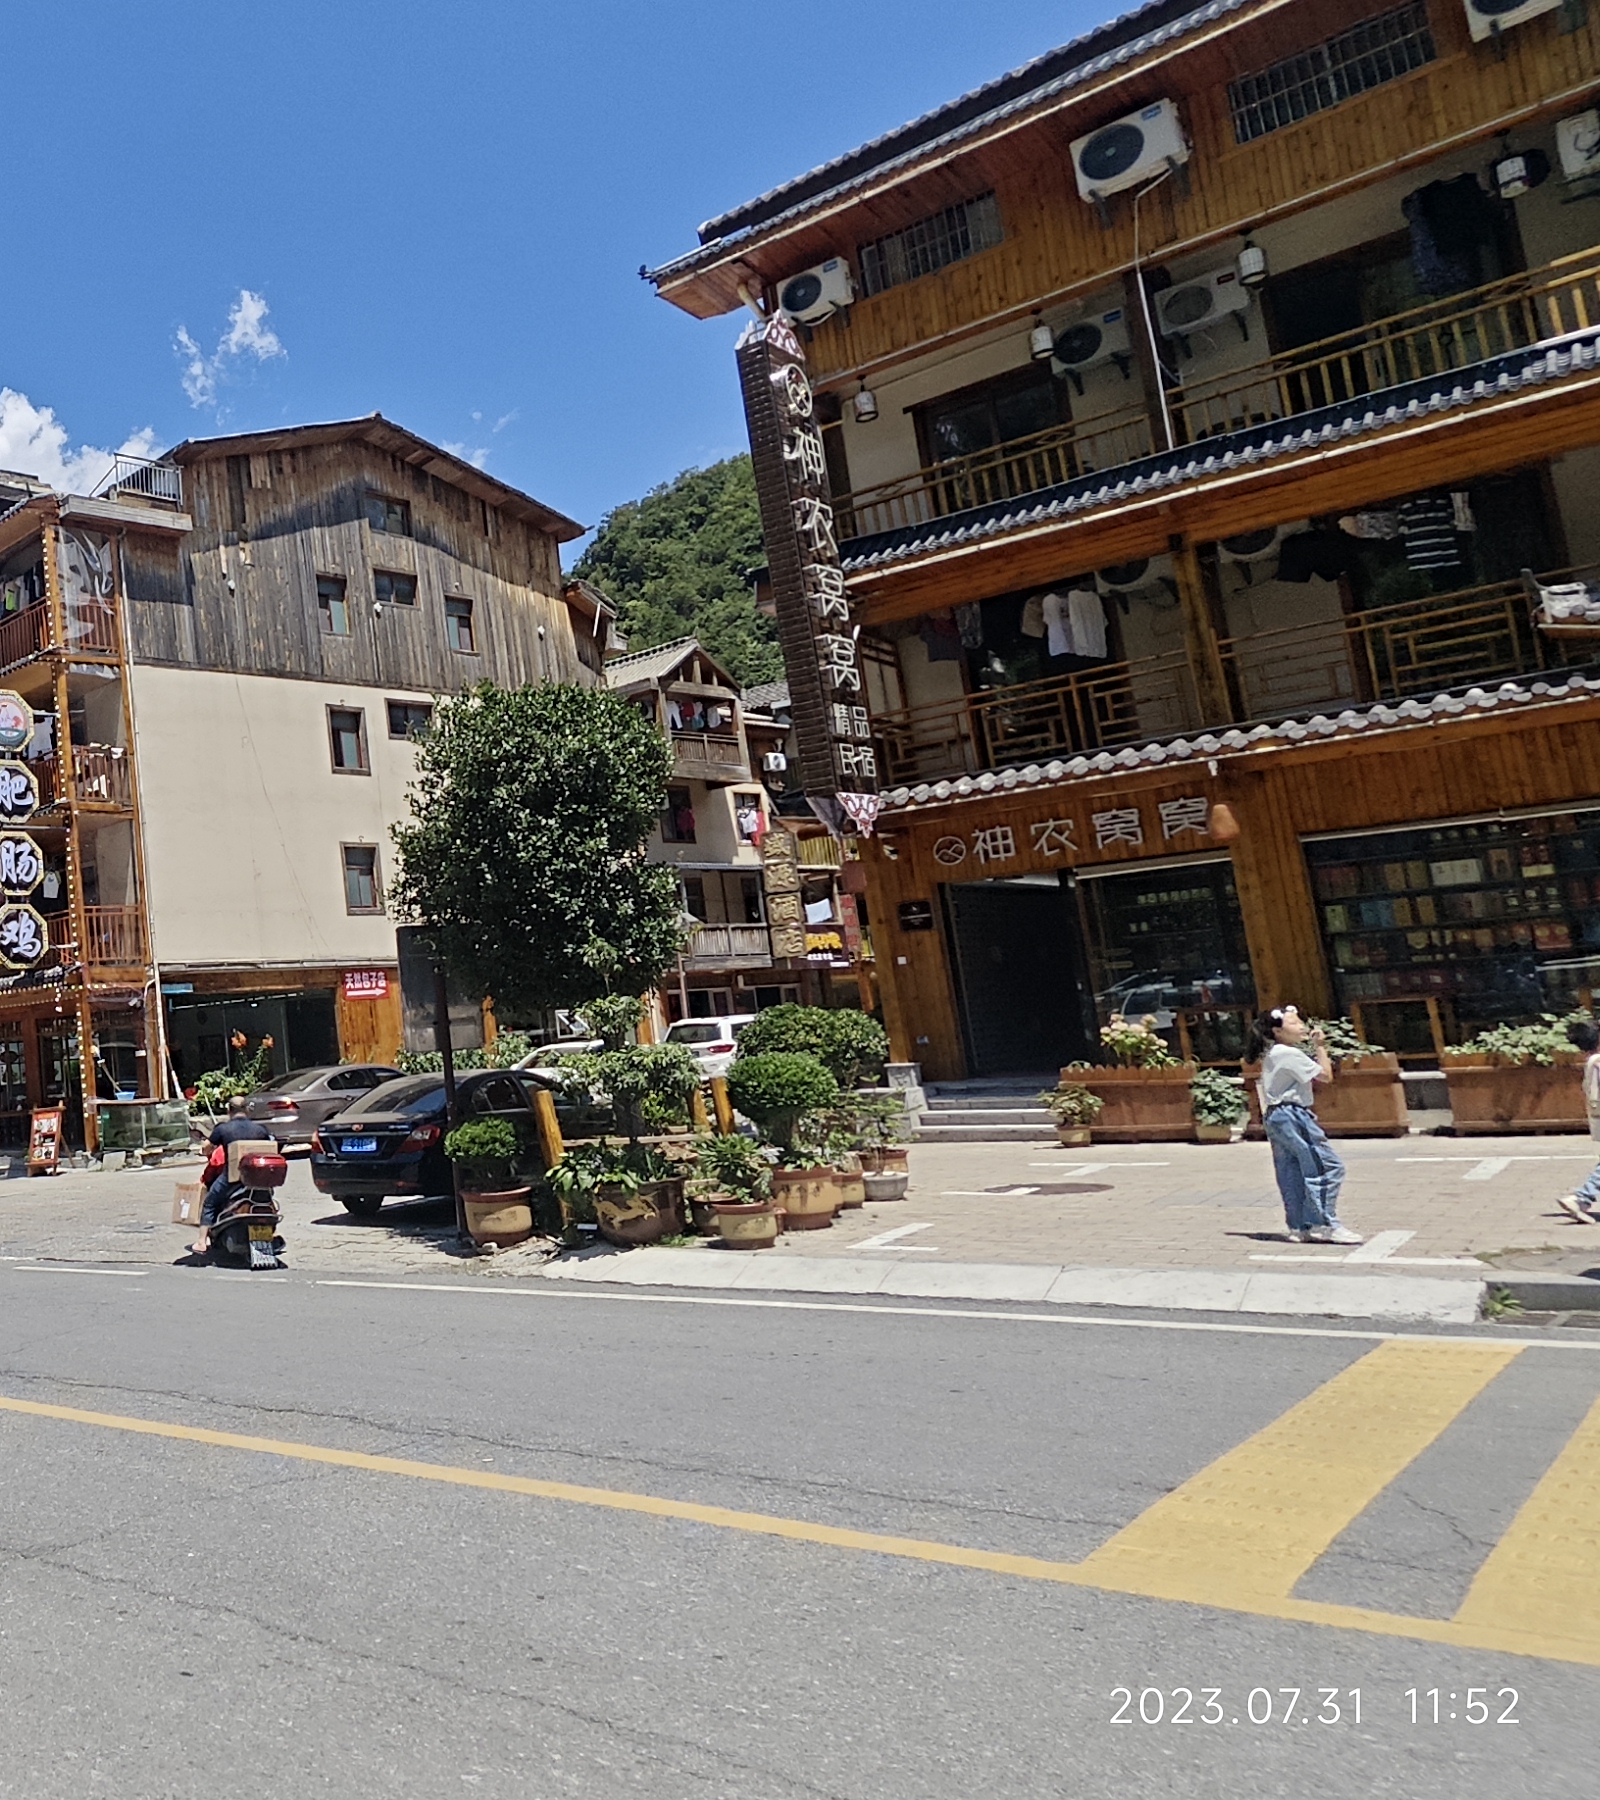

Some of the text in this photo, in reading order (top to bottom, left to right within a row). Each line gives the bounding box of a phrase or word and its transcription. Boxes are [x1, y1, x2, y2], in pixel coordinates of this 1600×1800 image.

[833, 702, 871, 738] 精品
[838, 743, 877, 777] 民宿
[971, 796, 1210, 864] 神农窝窝
